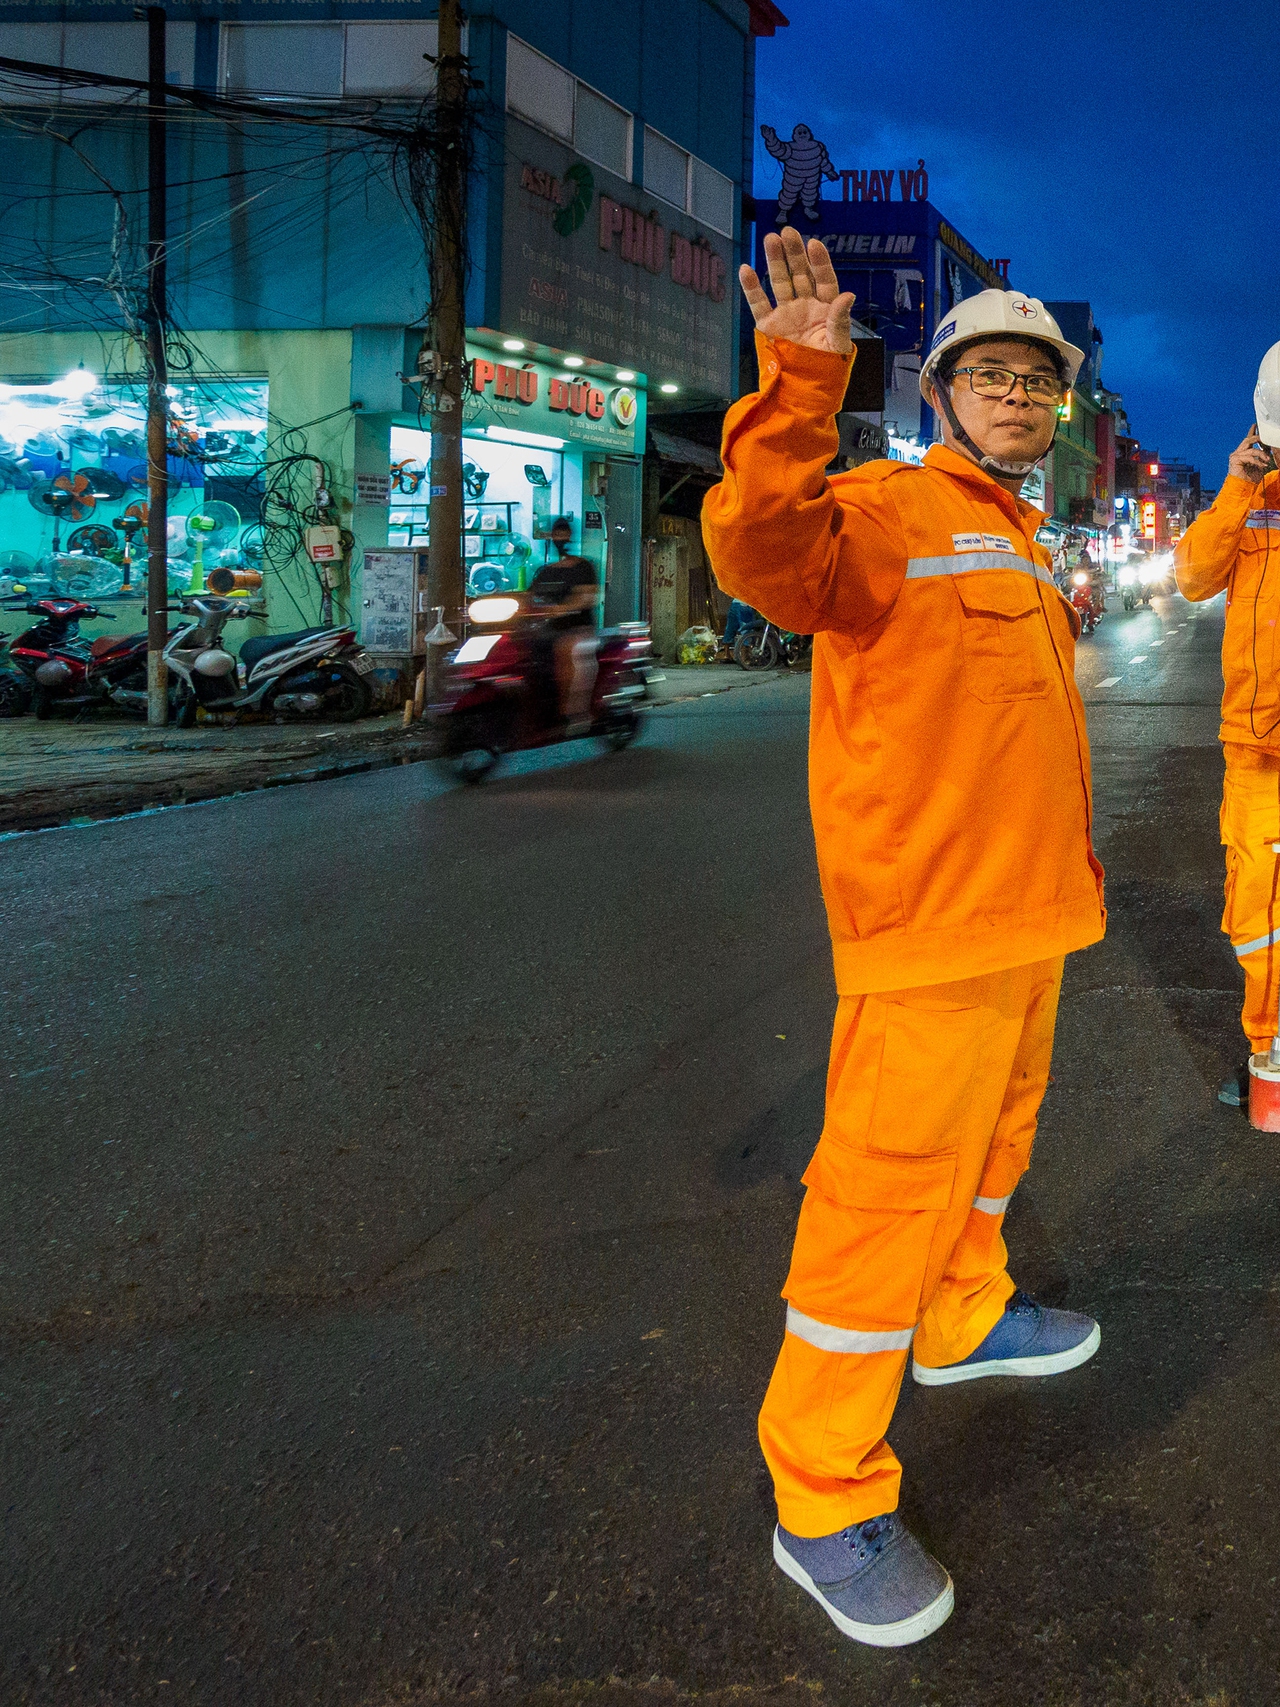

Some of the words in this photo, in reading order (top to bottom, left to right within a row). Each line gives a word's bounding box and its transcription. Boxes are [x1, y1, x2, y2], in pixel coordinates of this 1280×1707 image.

[840, 170, 894, 201] THAY
[899, 159, 928, 201] VỎ
[600, 195, 664, 275] PHÚ
[671, 231, 726, 303] ĐỨC
[802, 234, 916, 254] CHELIN
[529, 276, 568, 308] ASIA
[473, 358, 538, 404] PHÚ
[549, 377, 605, 419] ĐỨC
